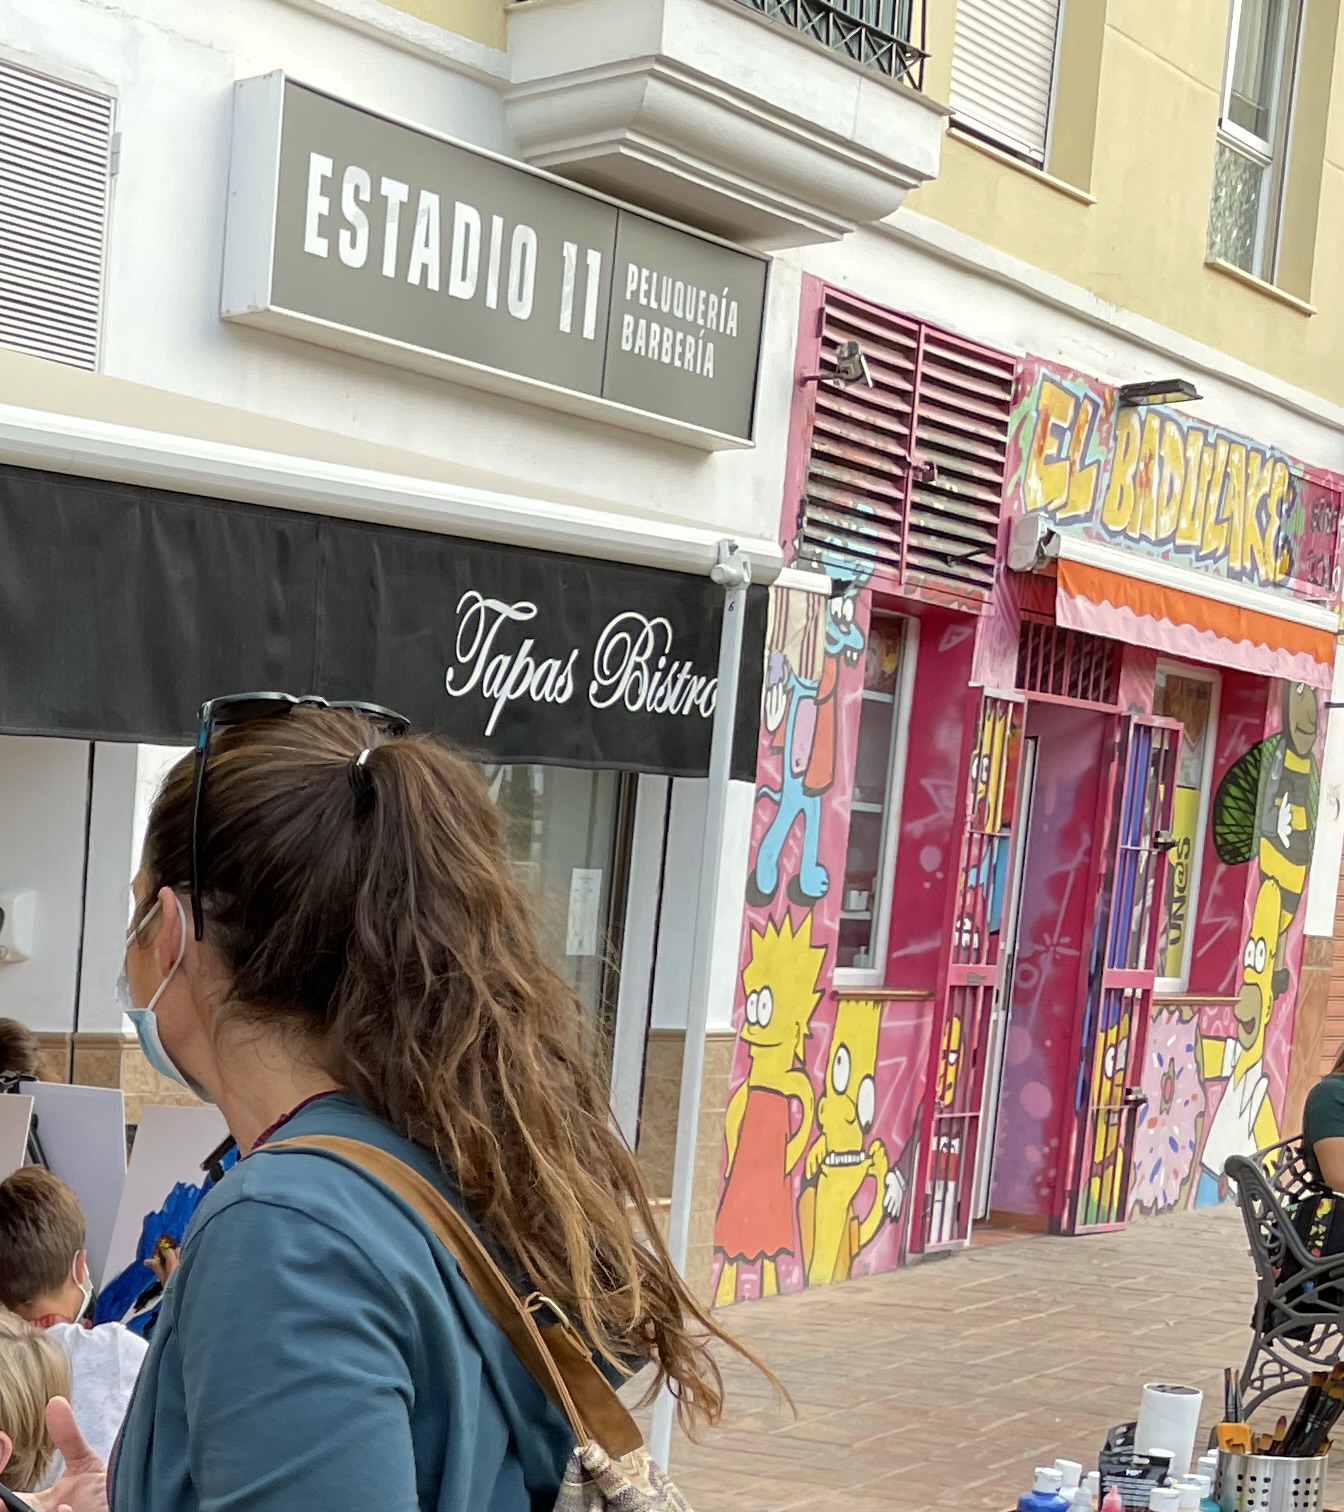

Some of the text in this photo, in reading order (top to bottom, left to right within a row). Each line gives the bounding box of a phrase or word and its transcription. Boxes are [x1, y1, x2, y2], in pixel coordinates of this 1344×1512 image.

[303, 151, 603, 341] ESTADIO 11
[625, 262, 740, 339] PELUQUERÍA
[620, 313, 715, 379] BARBERÍA
[1023, 378, 1295, 585] EL BADULAKE
[445, 590, 721, 738] Tapas Bistro
